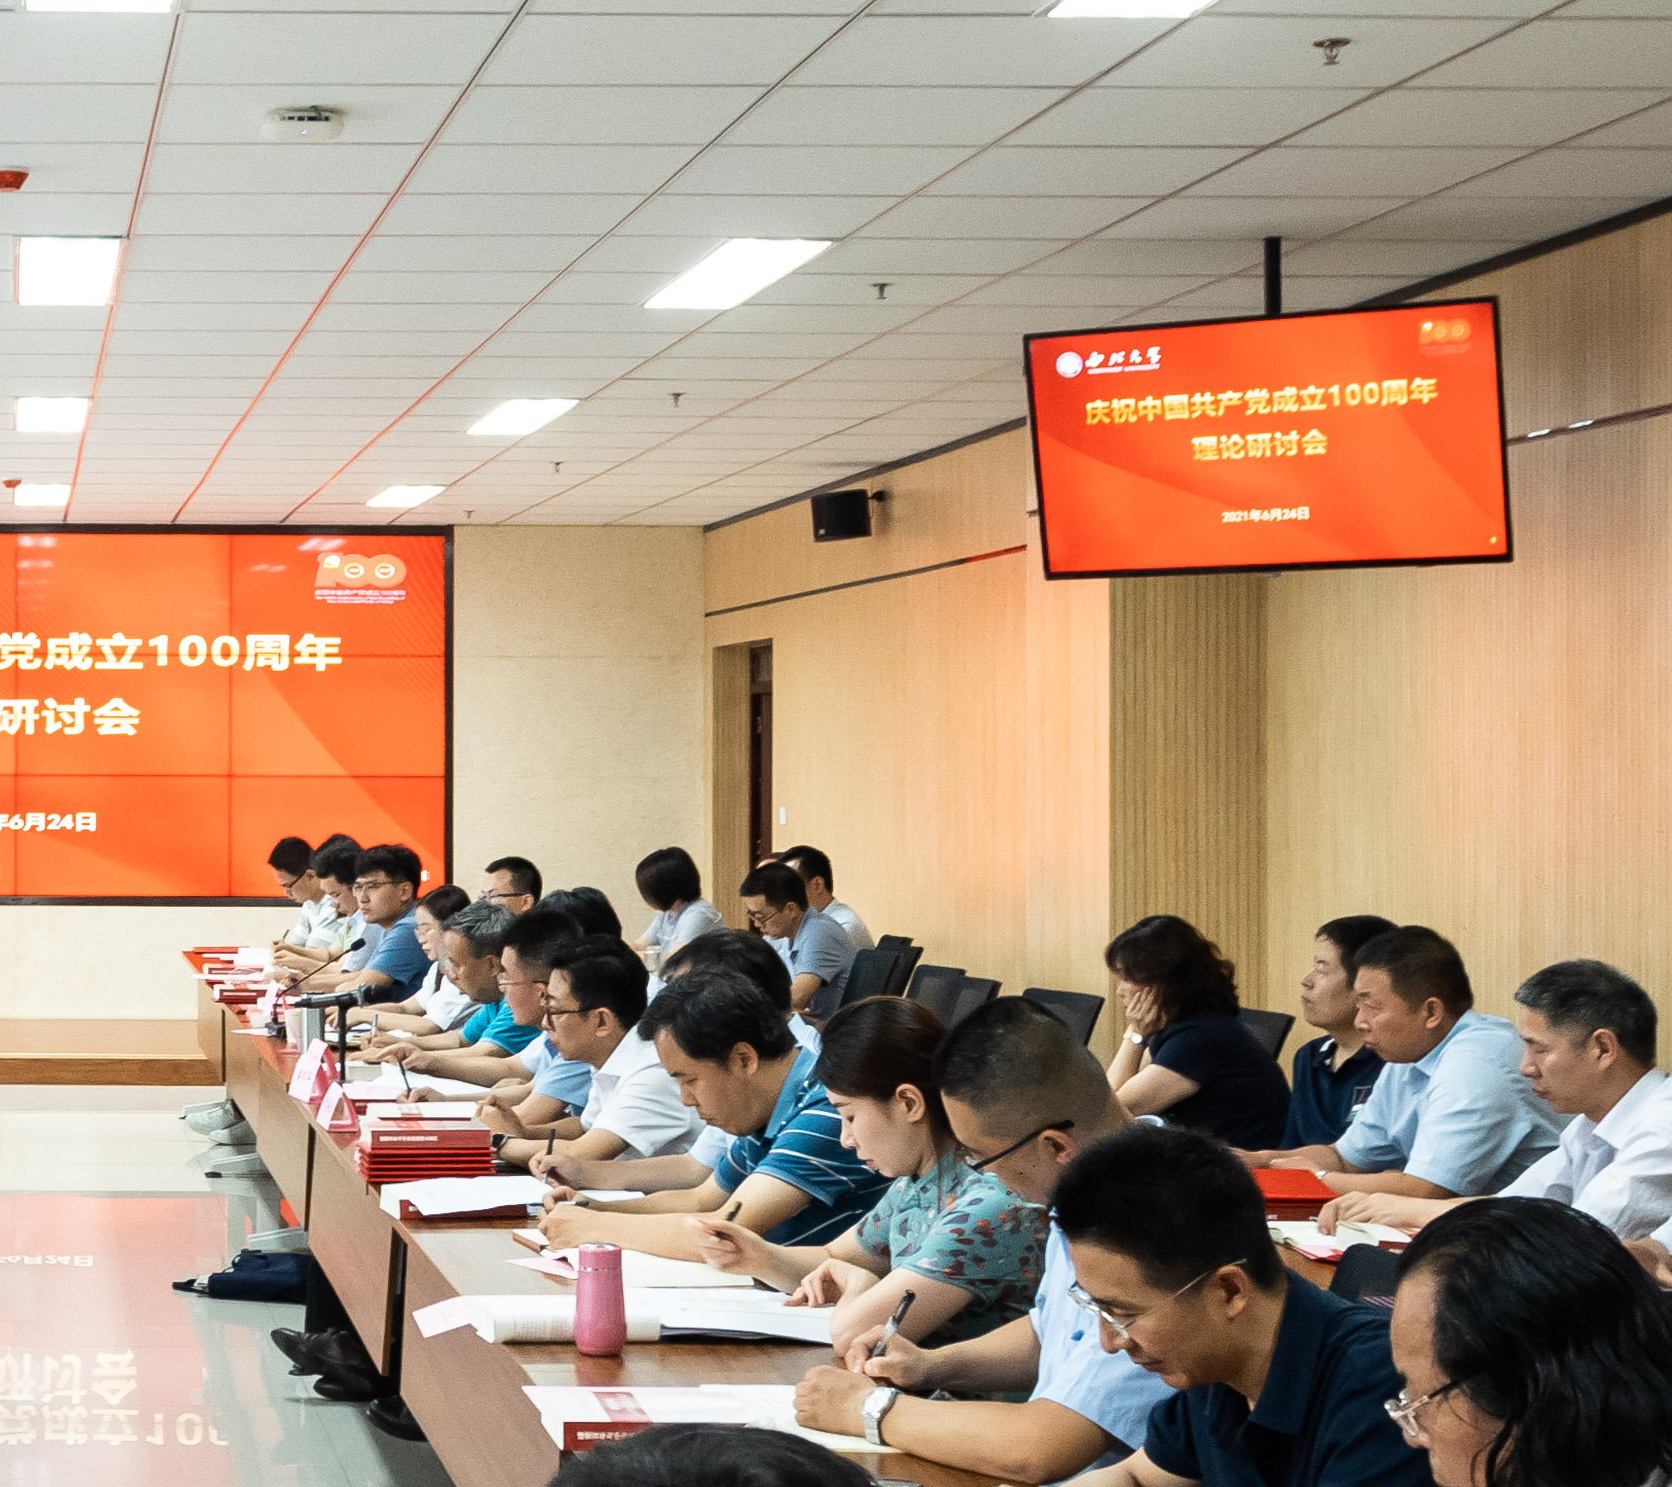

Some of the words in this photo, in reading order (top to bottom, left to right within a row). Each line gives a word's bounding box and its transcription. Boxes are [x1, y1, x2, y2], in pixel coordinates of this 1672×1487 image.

[1085, 376, 1439, 426] 庆祝中国共产党成立100周年
[1190, 428, 1328, 462] 理论研讨会
[1221, 505, 1311, 524] 2021年6月24日
